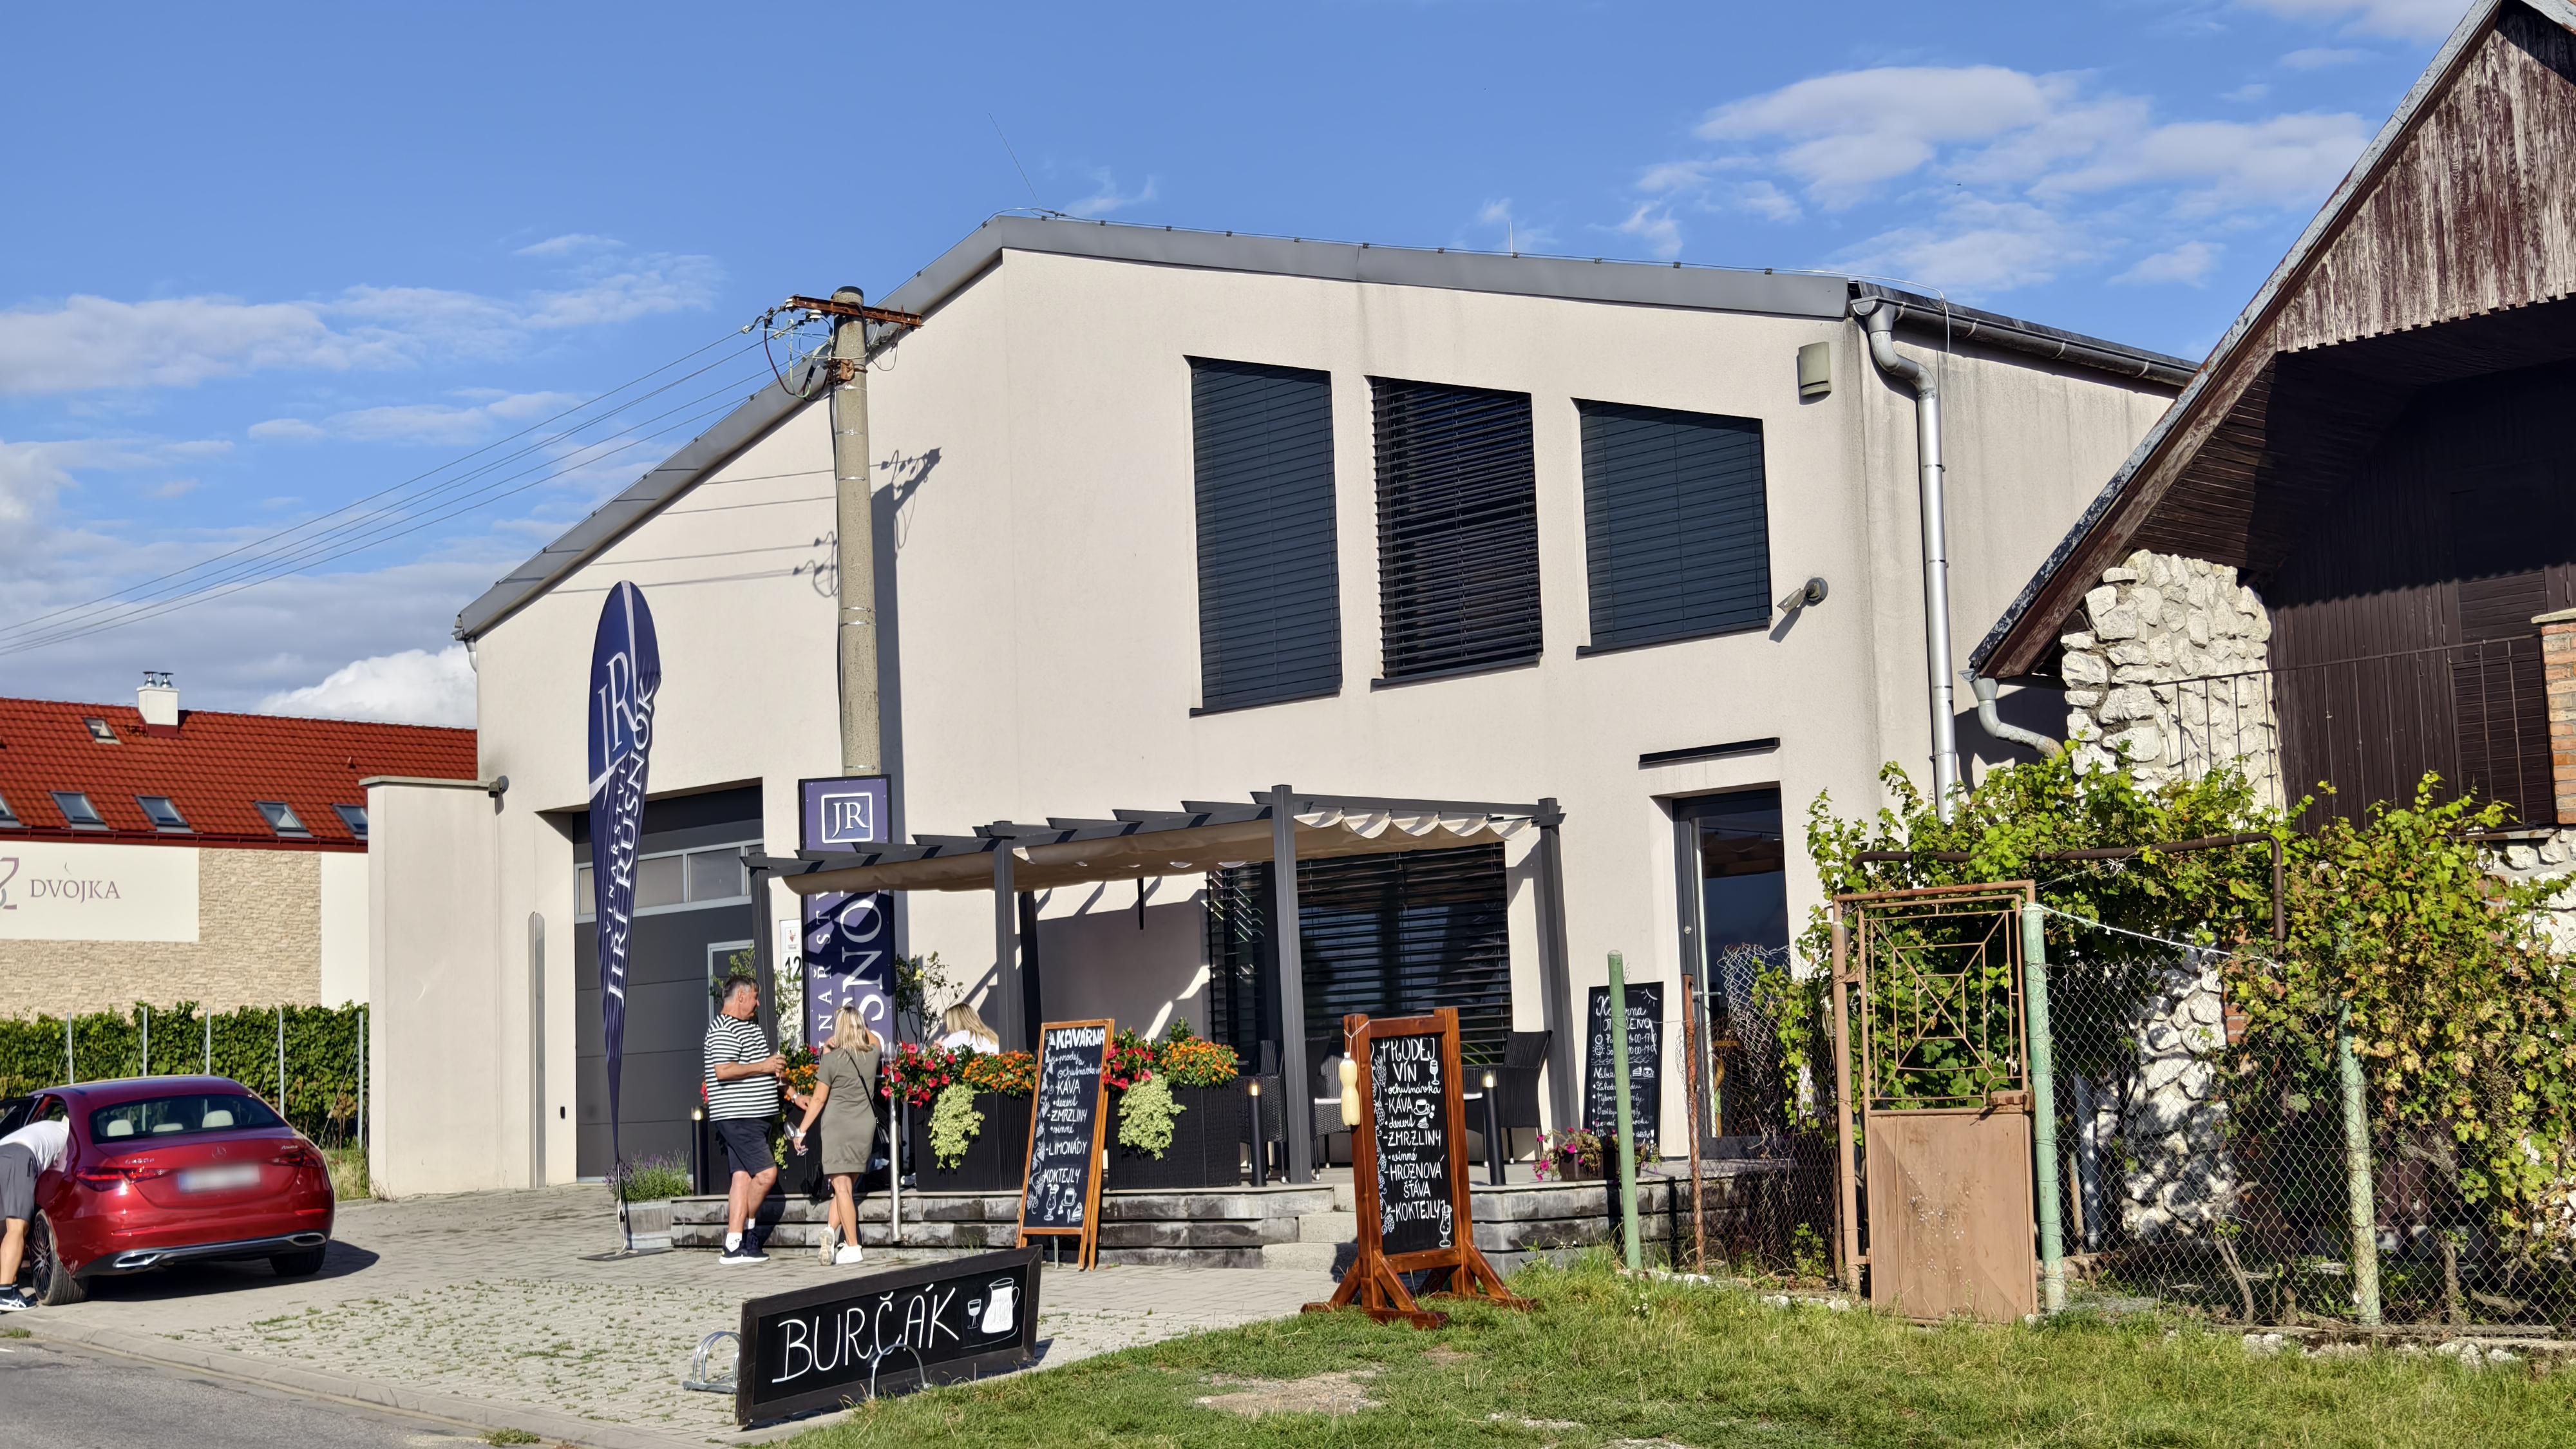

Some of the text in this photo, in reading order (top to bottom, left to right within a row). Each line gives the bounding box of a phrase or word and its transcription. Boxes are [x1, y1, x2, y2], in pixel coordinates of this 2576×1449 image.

[832, 802, 869, 838] JR
[606, 766, 626, 933] VINAŘSTVÍ
[608, 676, 654, 1008] JIŘÍ RUSNOK
[30, 879, 120, 903] DVOJKA
[1056, 1027, 1105, 1050] KAVÁRNA
[1379, 1037, 1435, 1063] PRODEJ
[1392, 1060, 1417, 1082] VÍN
[1388, 1081, 1441, 1094] ochutnávka
[1403, 1179, 1431, 1198] ŠŤÁVA
[772, 1283, 960, 1383] BURČÁK
